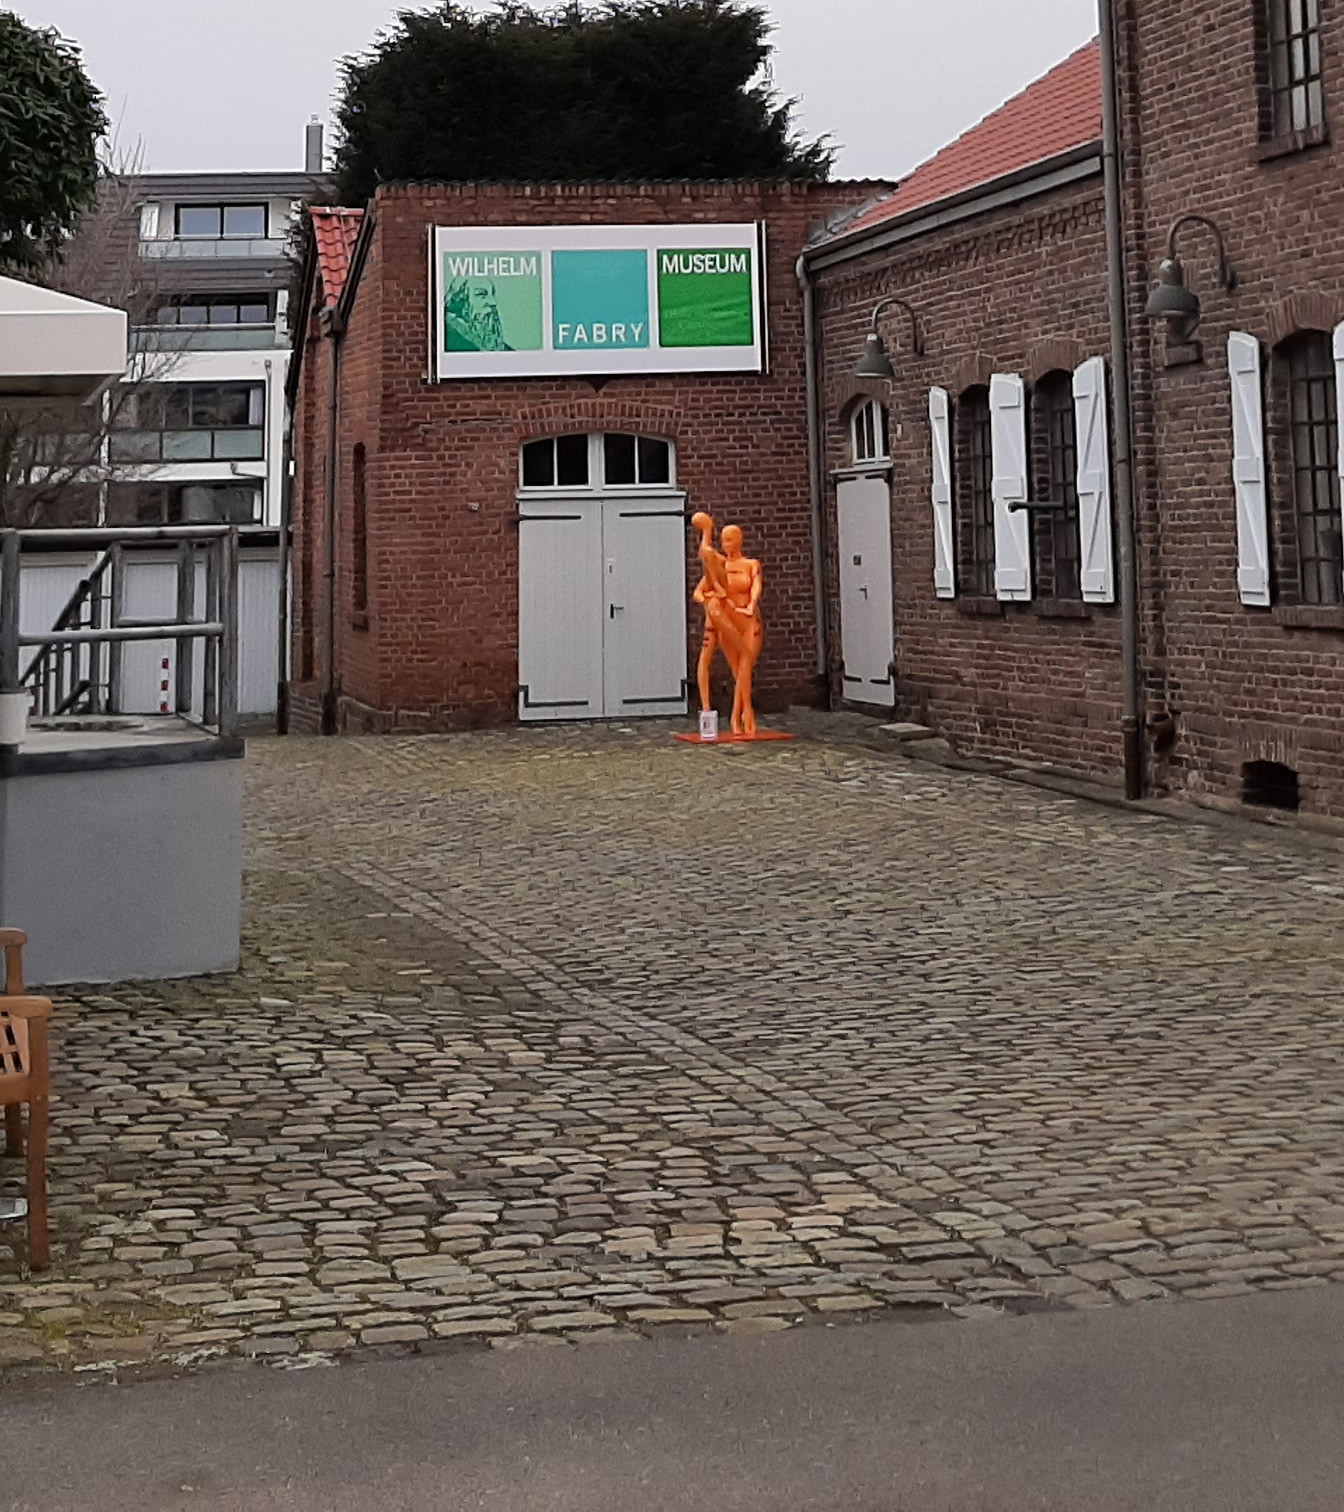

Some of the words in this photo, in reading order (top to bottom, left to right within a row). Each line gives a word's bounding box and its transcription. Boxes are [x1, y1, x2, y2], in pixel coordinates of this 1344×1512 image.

[448, 255, 537, 277] WILHELM
[662, 253, 747, 275] MUSEUM
[558, 322, 643, 344] FABRY
